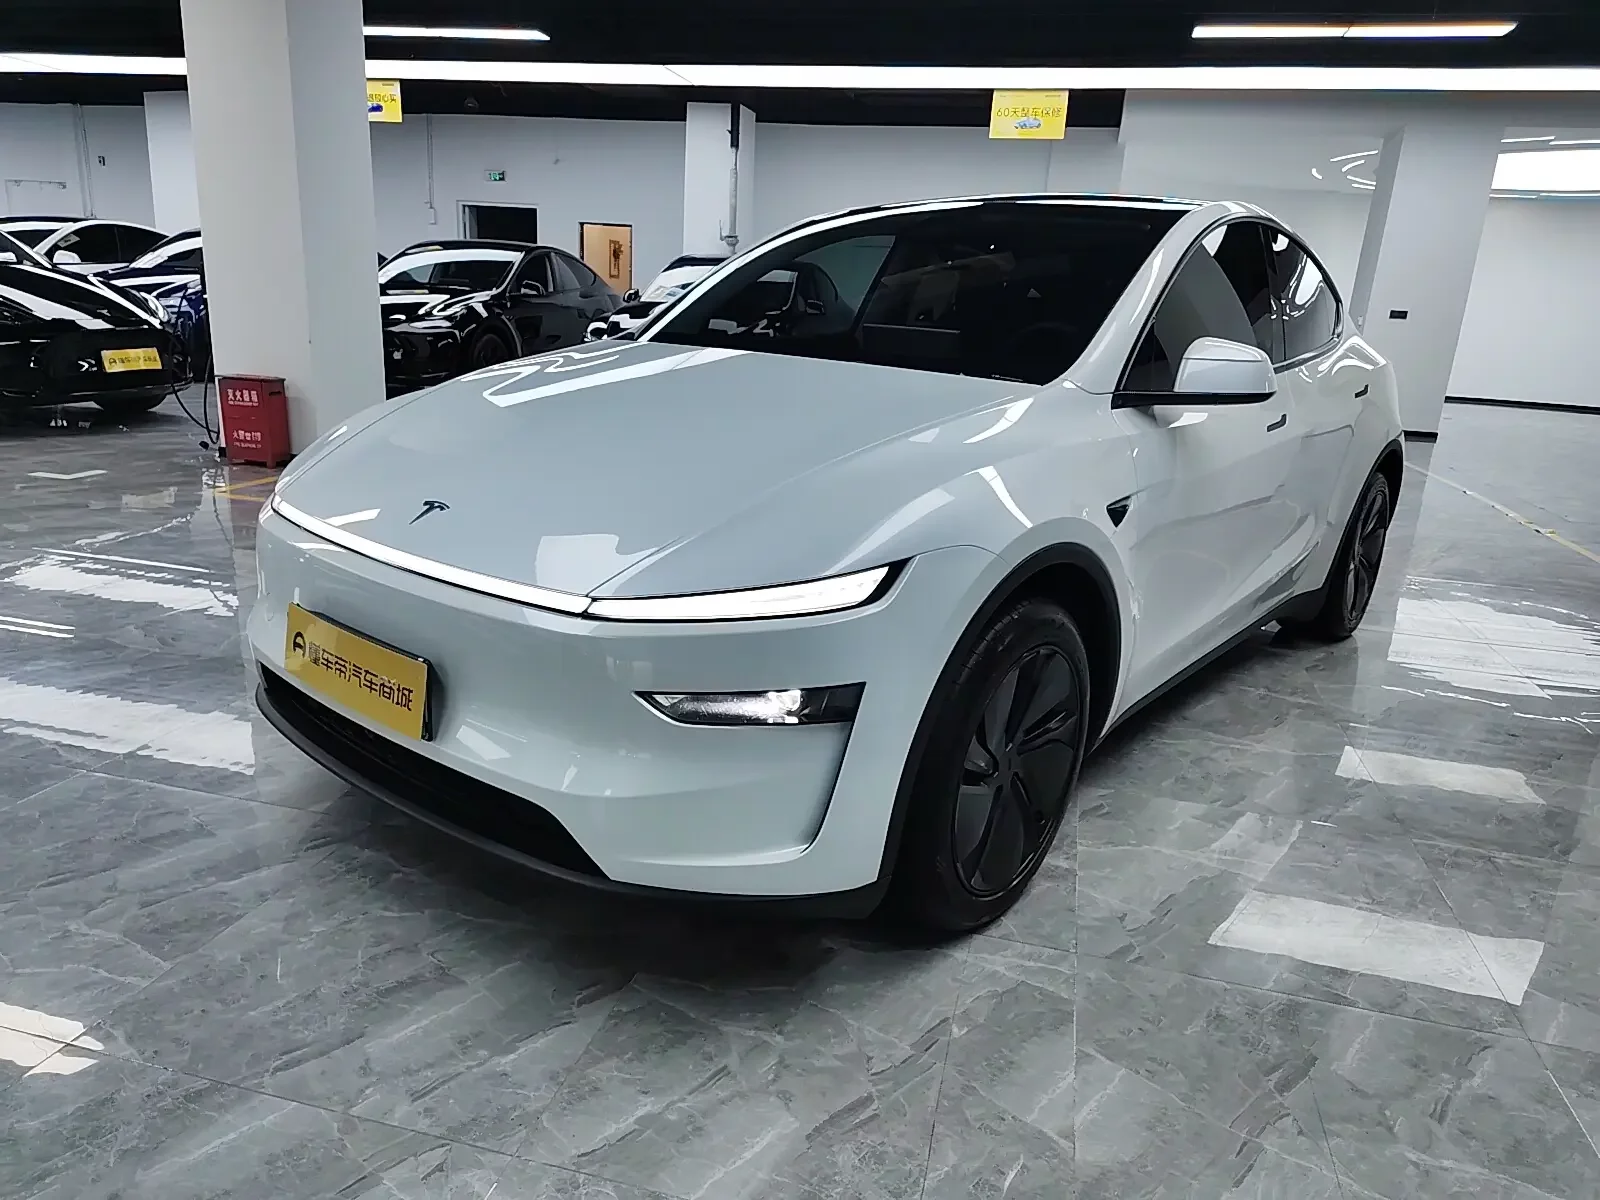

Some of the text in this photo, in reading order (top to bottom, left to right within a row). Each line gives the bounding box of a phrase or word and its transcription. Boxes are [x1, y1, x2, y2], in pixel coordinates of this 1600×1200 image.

[308, 641, 414, 711] 懂车帝汽车商城
